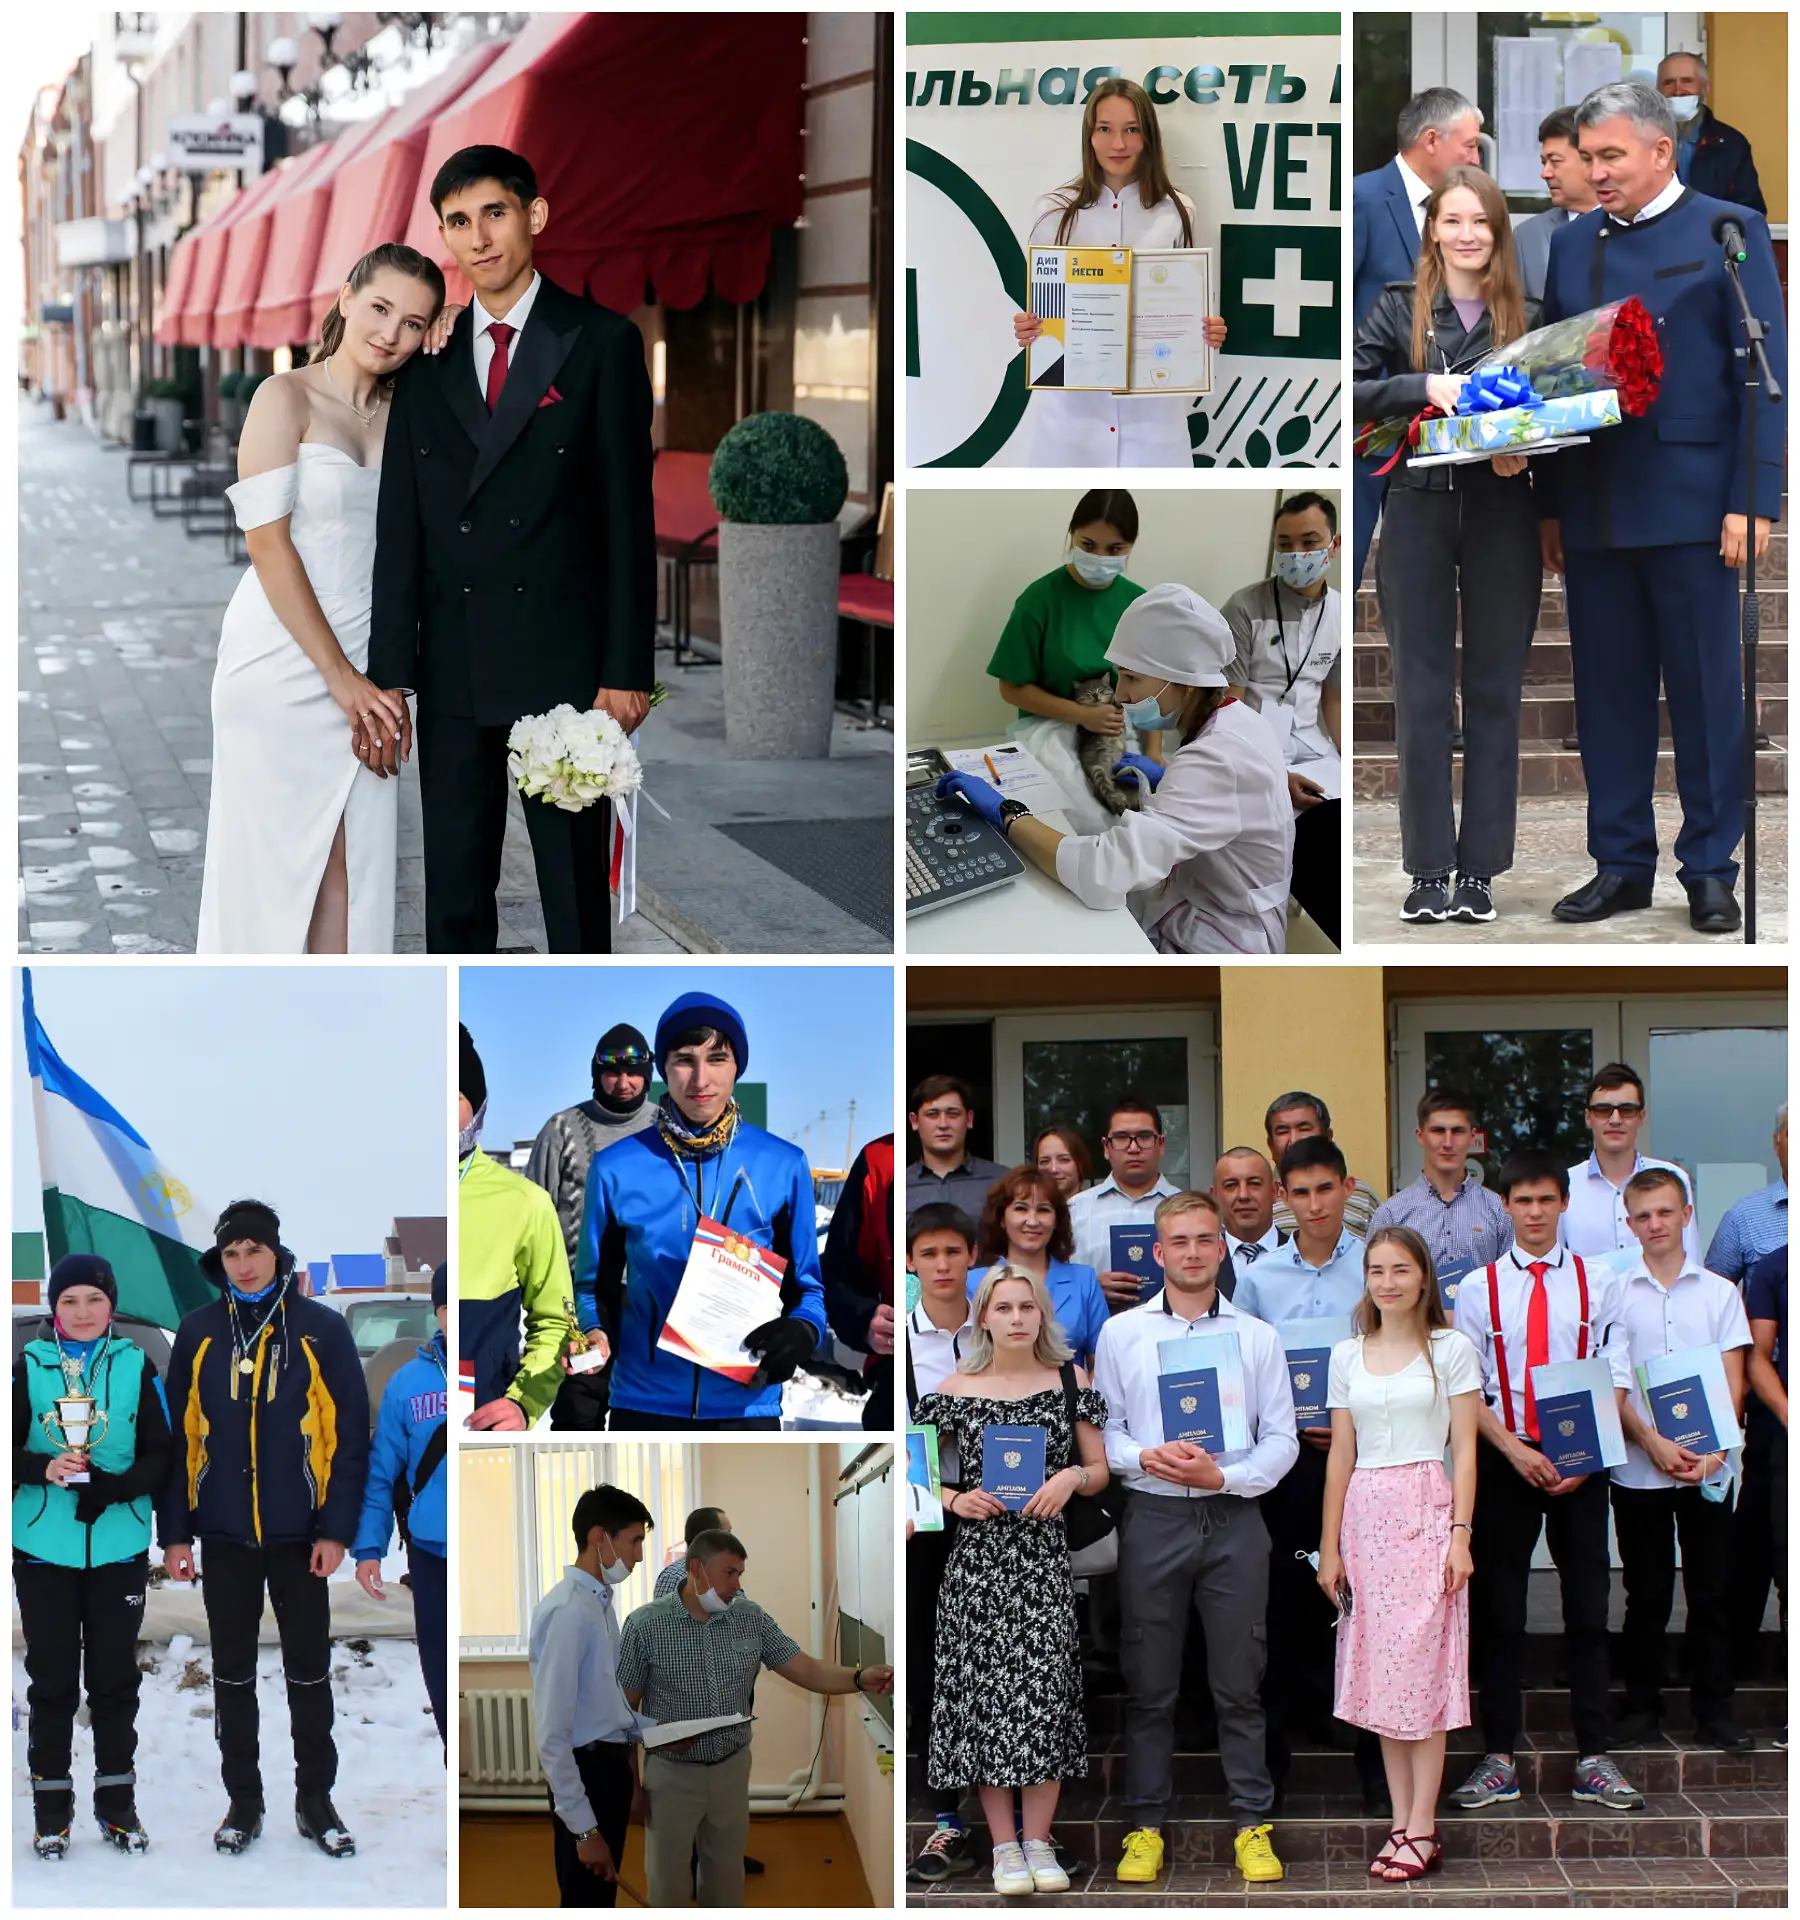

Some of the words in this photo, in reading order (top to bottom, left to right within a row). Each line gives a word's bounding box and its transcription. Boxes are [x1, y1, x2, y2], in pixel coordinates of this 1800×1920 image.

[1143, 64, 1306, 105] сеть
[1036, 256, 1058, 266] ДИП
[1072, 257, 1078, 266] 3
[1036, 267, 1058, 275] ЛОМ
[1072, 268, 1104, 276] МЕСТО
[711, 1247, 761, 1282] Грамота
[1178, 1428, 1207, 1439] ДИПЛОМ
